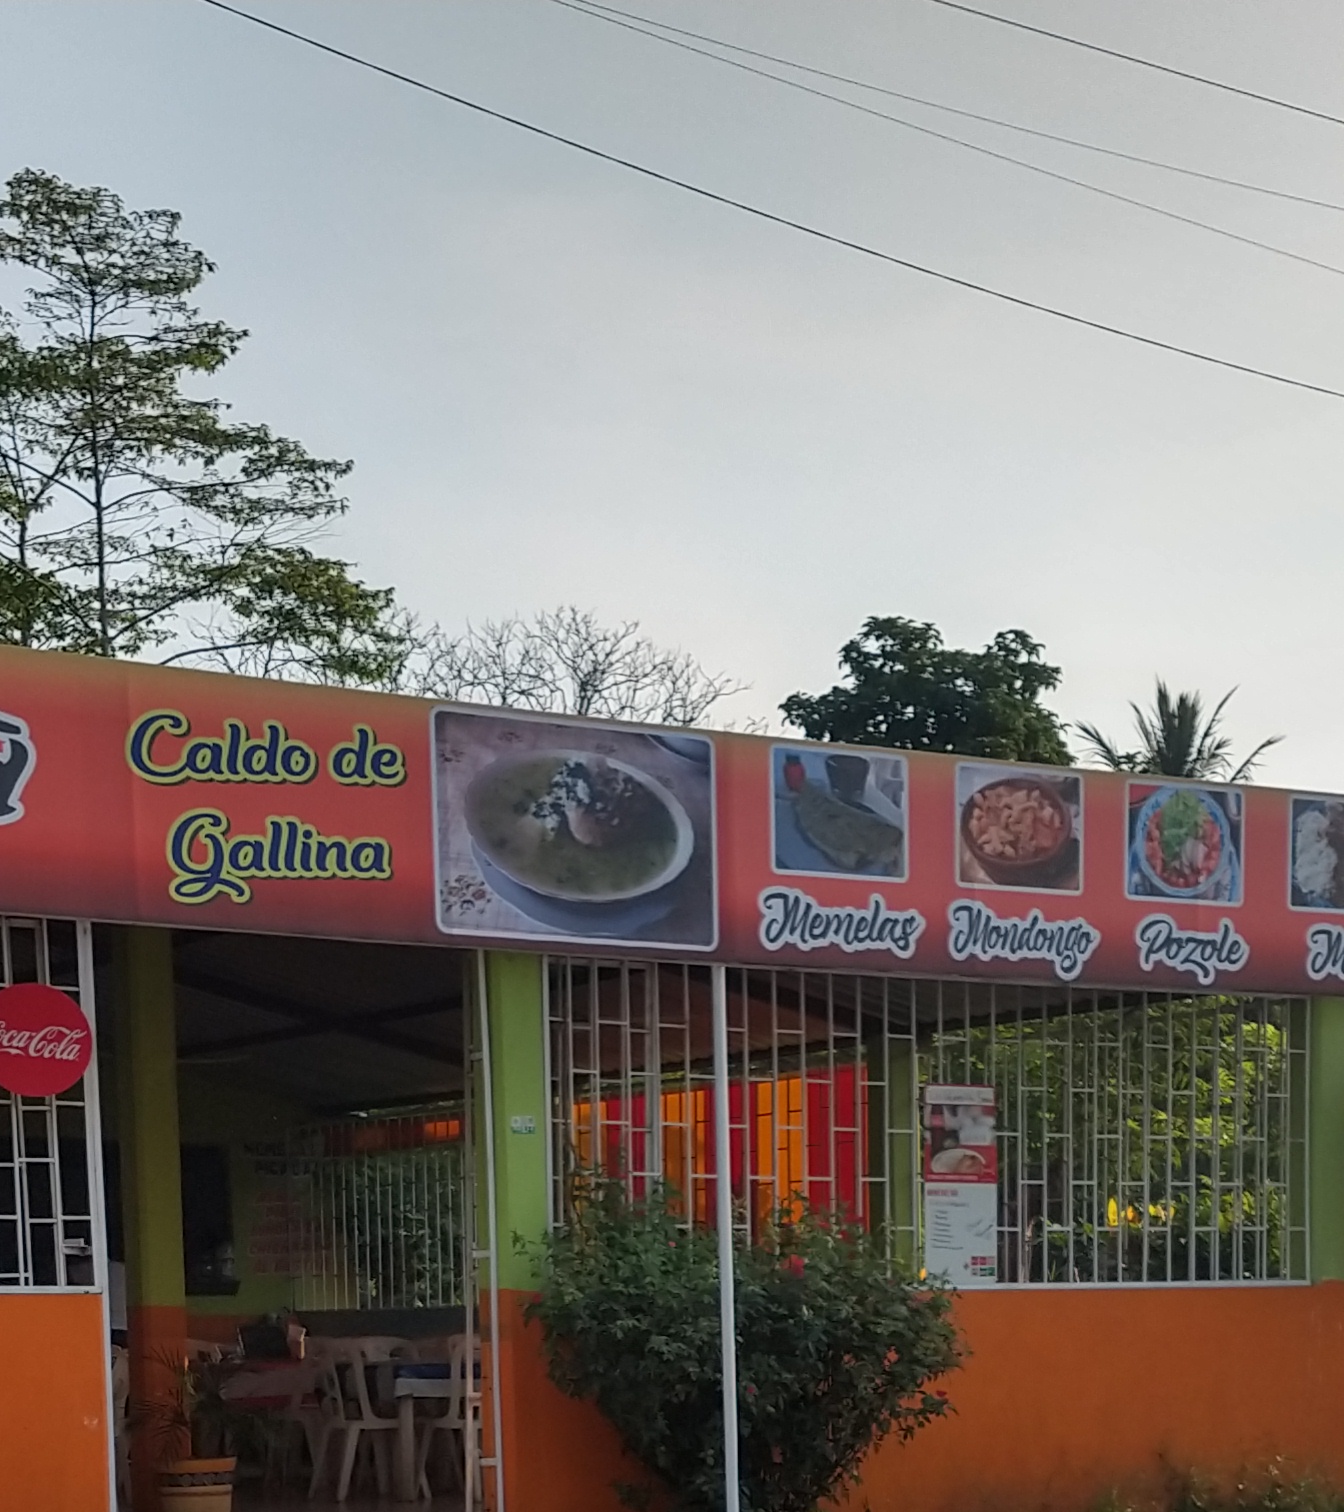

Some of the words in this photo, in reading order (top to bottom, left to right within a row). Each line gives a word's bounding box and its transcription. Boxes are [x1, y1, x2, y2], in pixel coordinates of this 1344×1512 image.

[127, 710, 316, 784] Caldo
[330, 725, 406, 787] de
[167, 808, 392, 904] Gallina
[761, 890, 920, 952] Memelas
[951, 903, 1094, 975] Mondongo
[1138, 918, 1246, 980] Pozole
